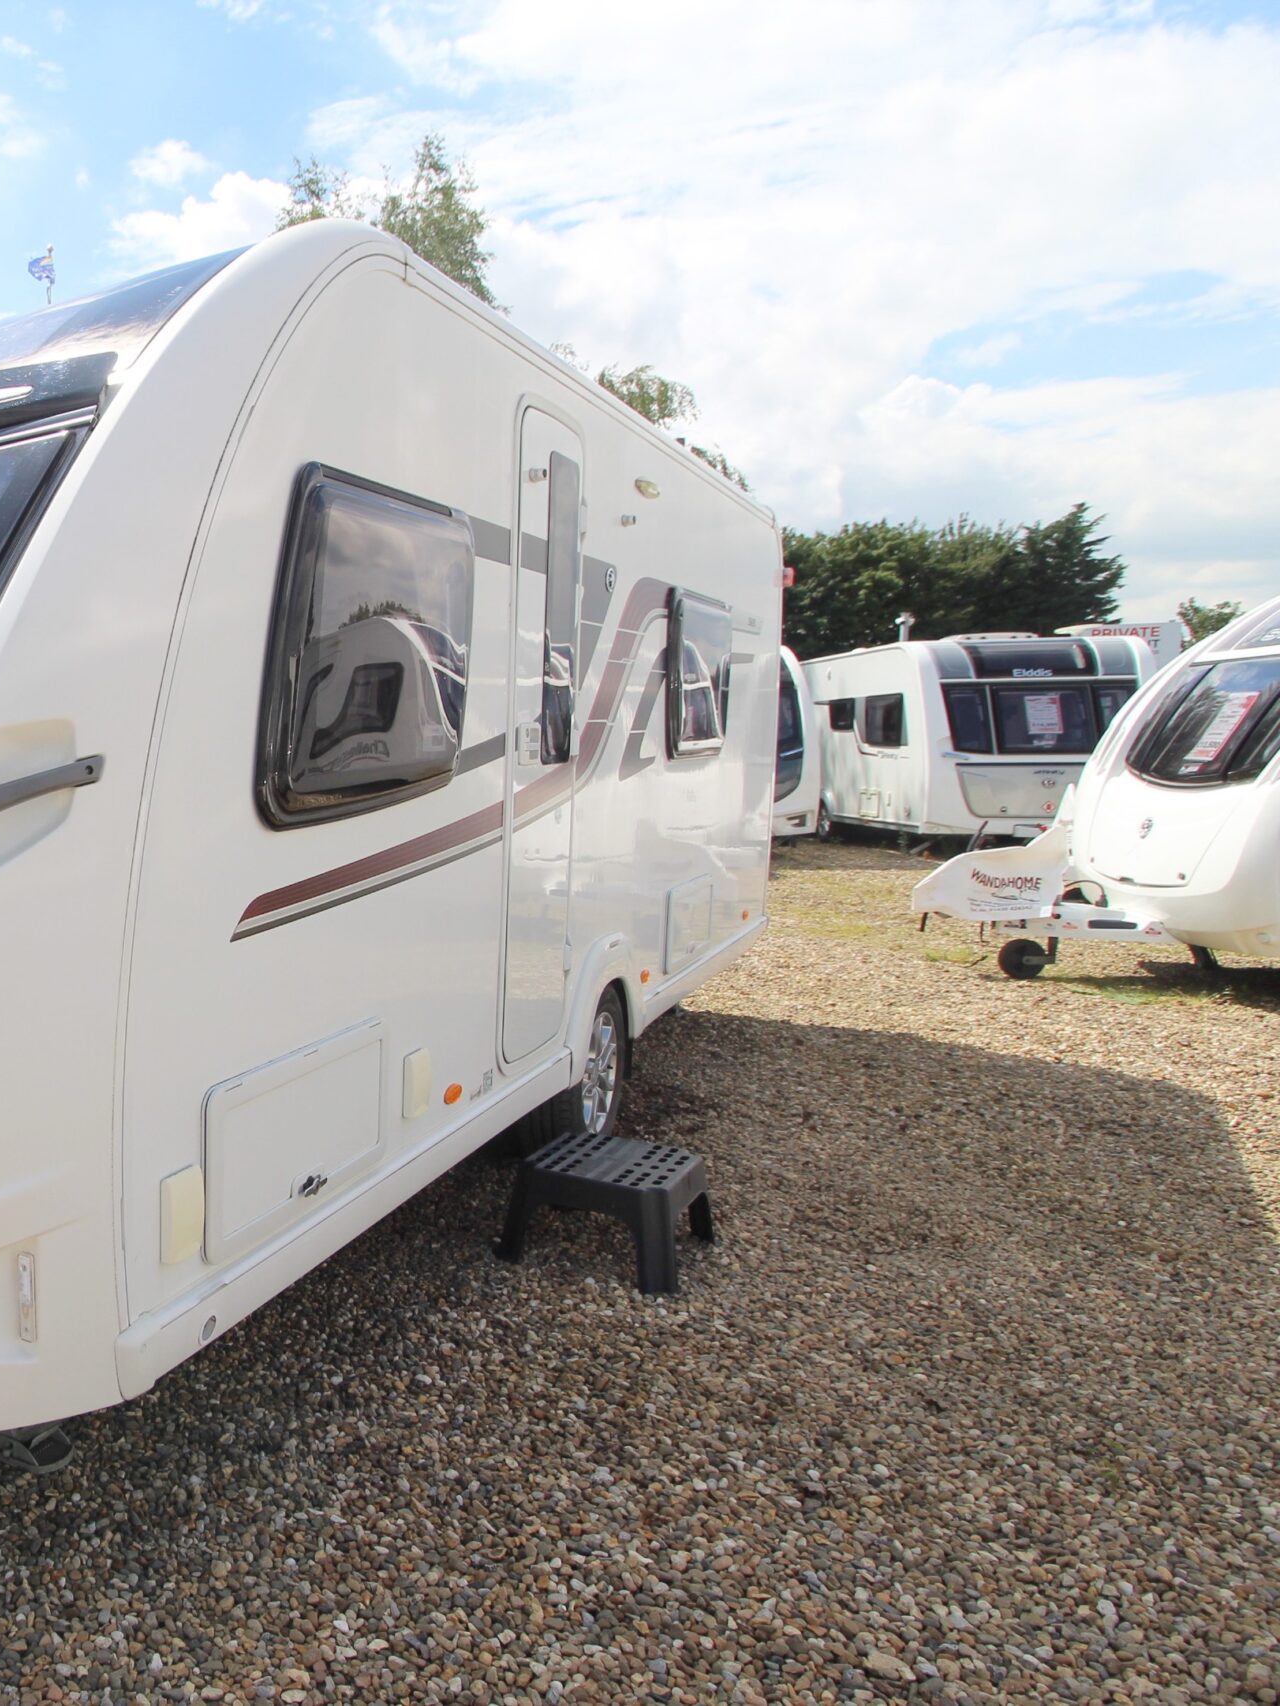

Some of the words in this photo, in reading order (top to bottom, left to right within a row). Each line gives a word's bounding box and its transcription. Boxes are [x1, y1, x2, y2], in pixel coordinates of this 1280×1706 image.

[1091, 626, 1161, 637] PRIVATE
[1012, 668, 1053, 677] Elddis
[970, 867, 1042, 889] WANDAHOME
